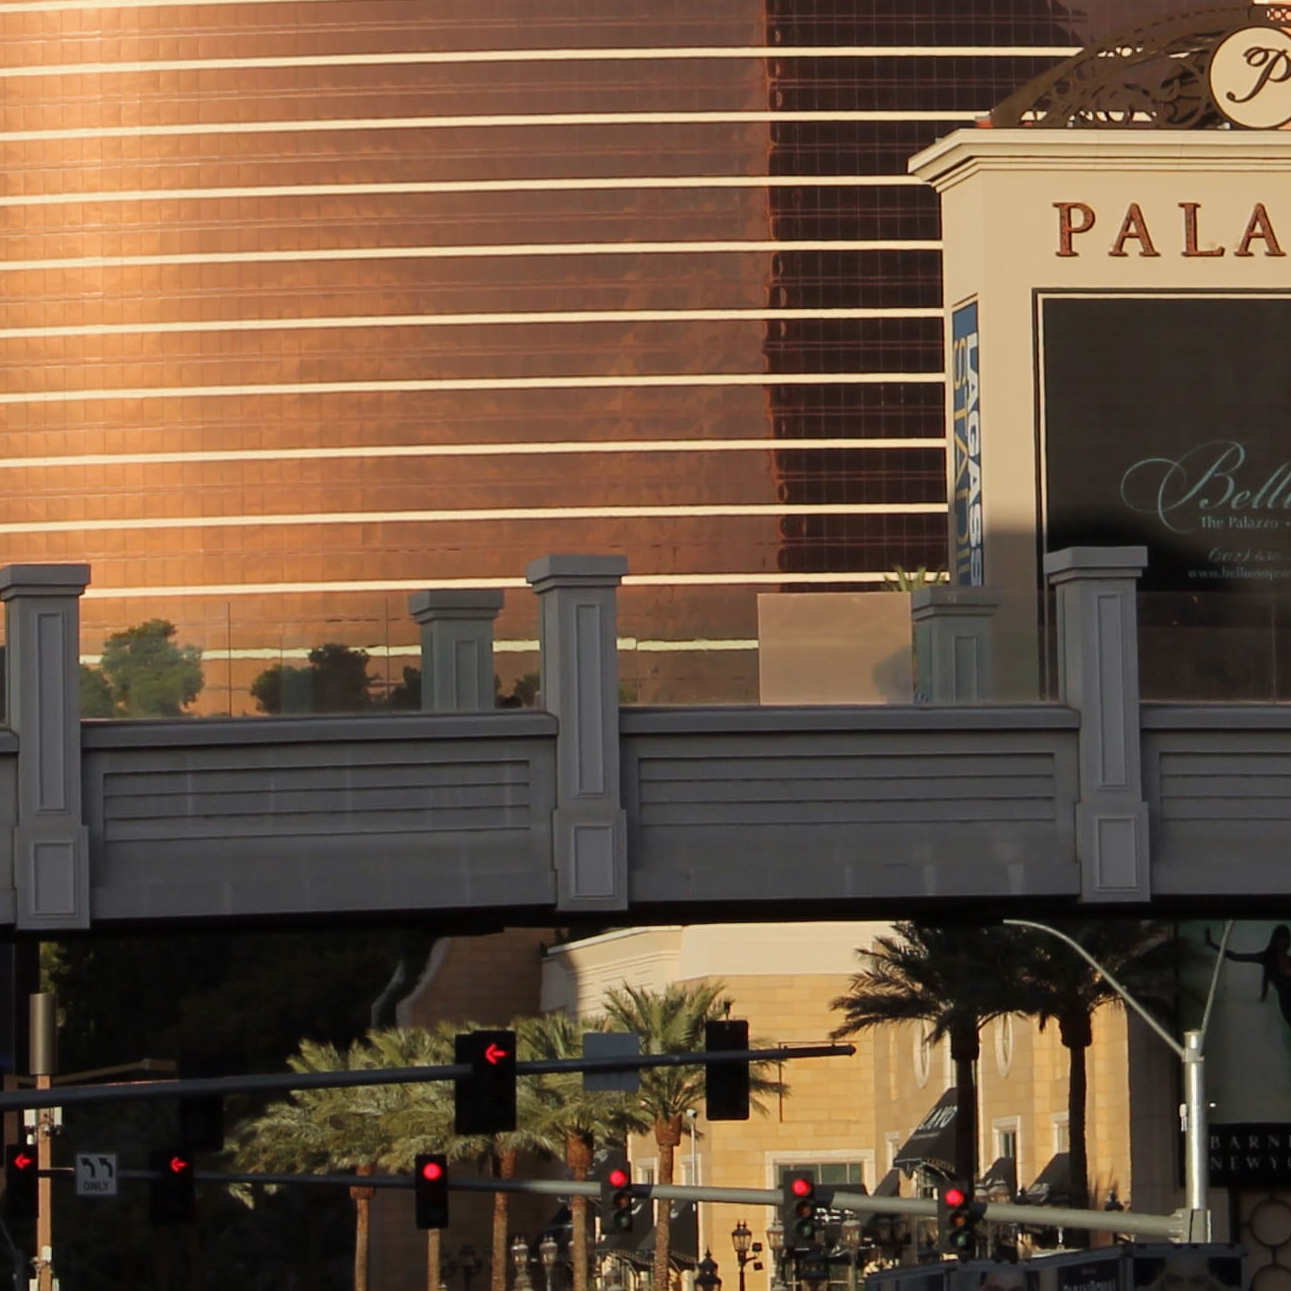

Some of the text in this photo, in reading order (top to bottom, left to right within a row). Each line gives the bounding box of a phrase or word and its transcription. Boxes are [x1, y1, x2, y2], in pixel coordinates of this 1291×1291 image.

[1200, 515, 1224, 530] The
[1228, 515, 1279, 530] Palazzo
[1210, 1155, 1261, 1172] NEW
[83, 1180, 110, 1191] ONLY
